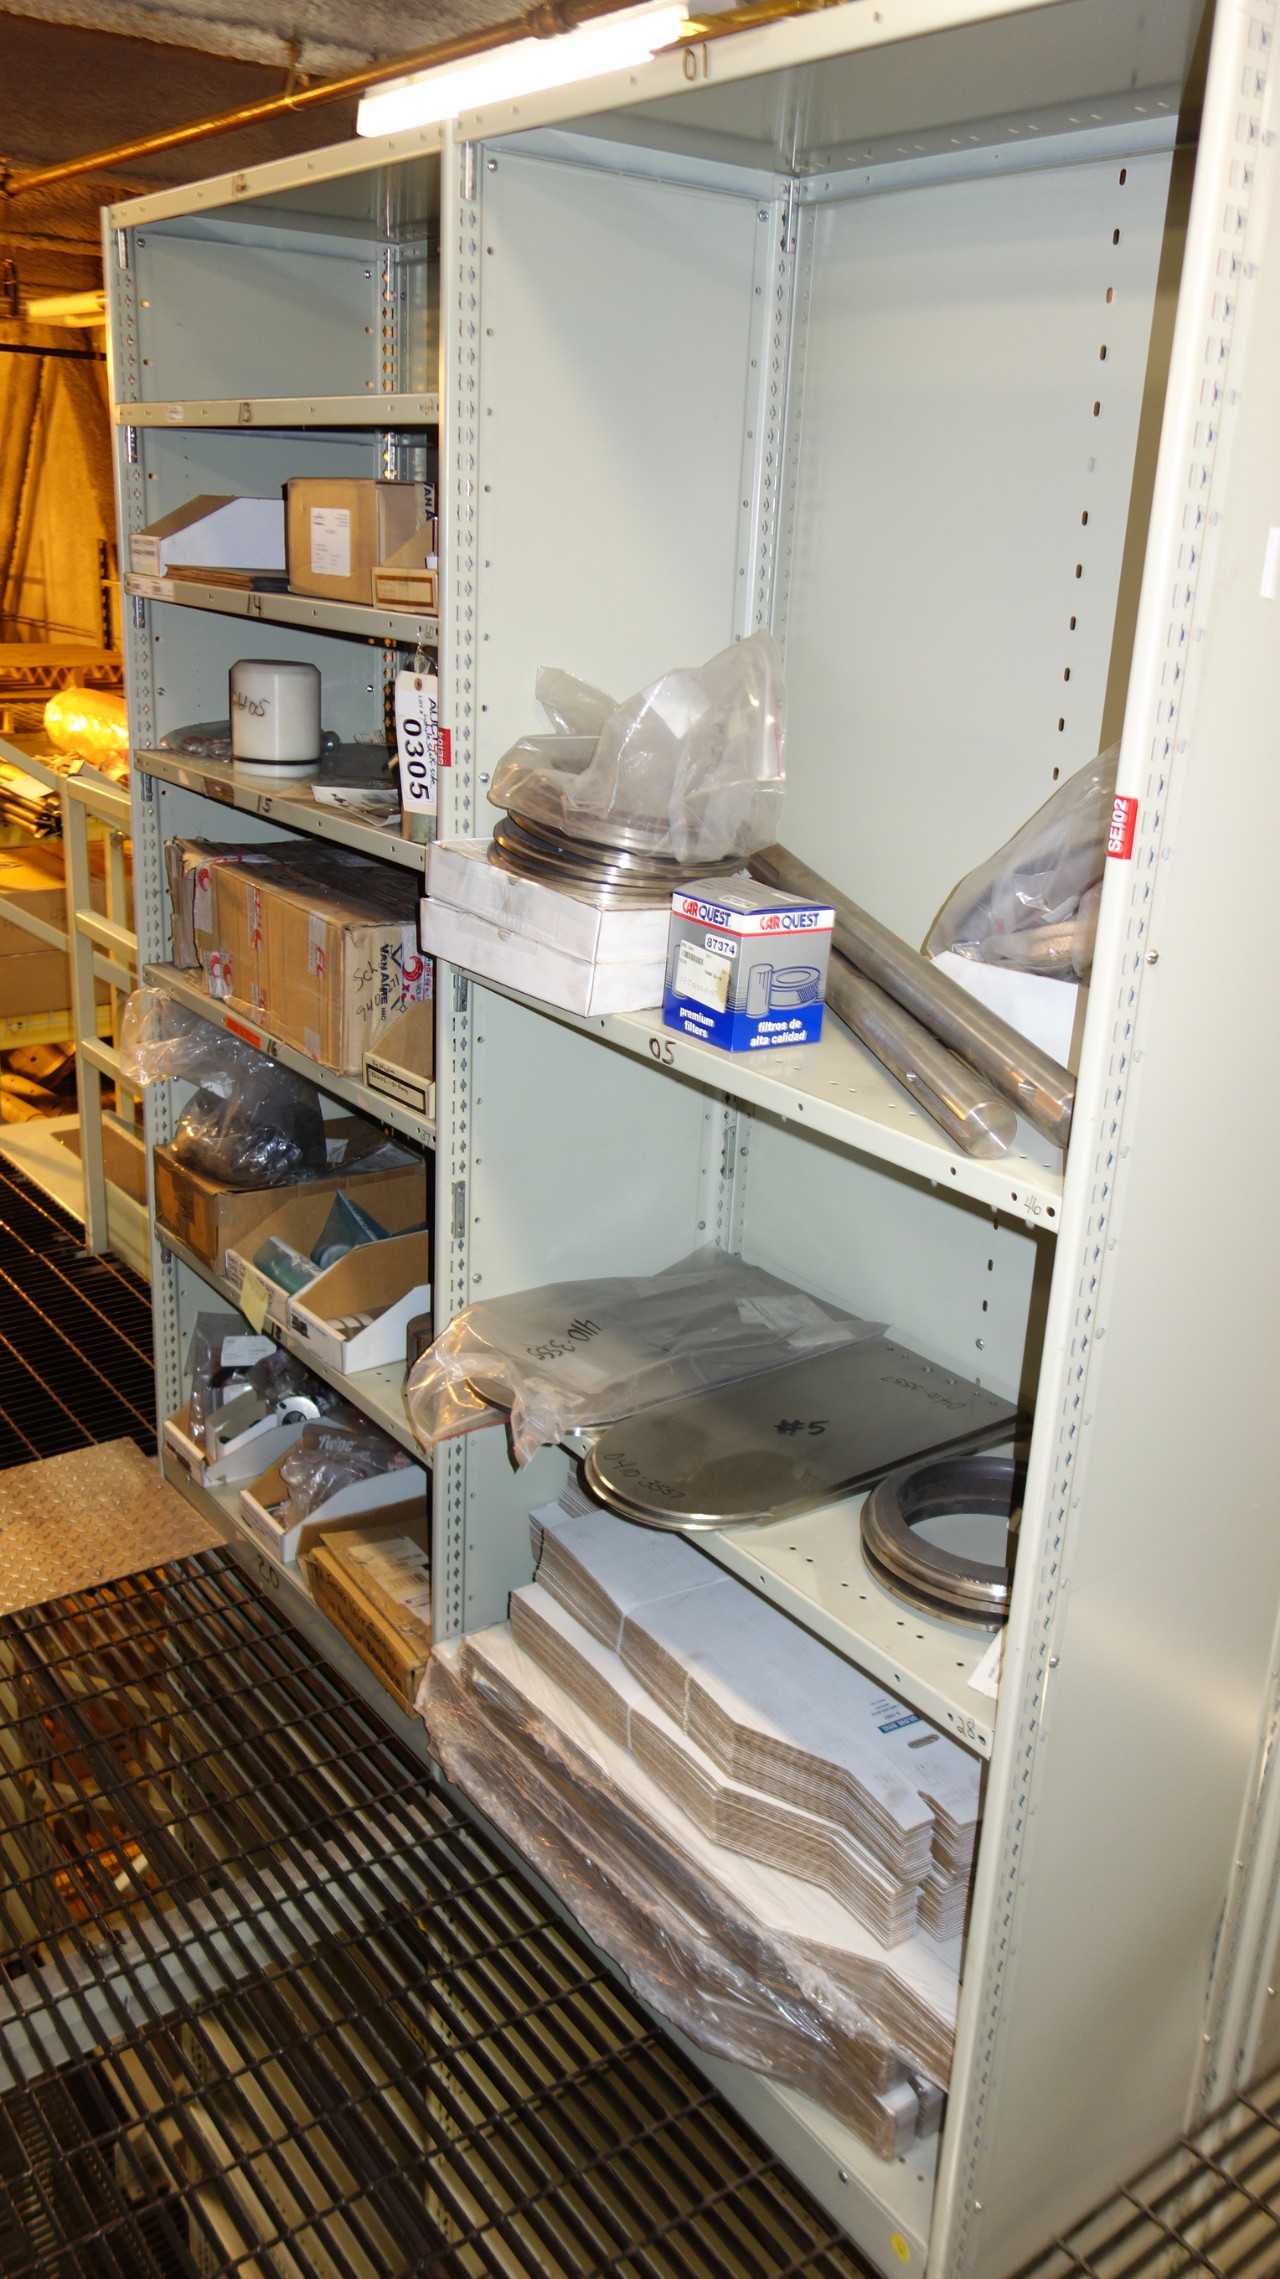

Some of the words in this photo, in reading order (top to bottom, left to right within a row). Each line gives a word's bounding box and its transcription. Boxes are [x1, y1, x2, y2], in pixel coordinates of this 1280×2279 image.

[246, 592, 263, 617] 14
[402, 718, 430, 800] 0305
[256, 794, 273, 813] 15
[705, 937, 736, 956] 87374
[679, 1006, 716, 1028] premium
[757, 1019, 788, 1033] filtros
[788, 1018, 802, 1028] de
[683, 1021, 709, 1038] filters
[750, 1035, 771, 1047] alta
[771, 1031, 807, 1045] calidad
[648, 1037, 677, 1066] 05
